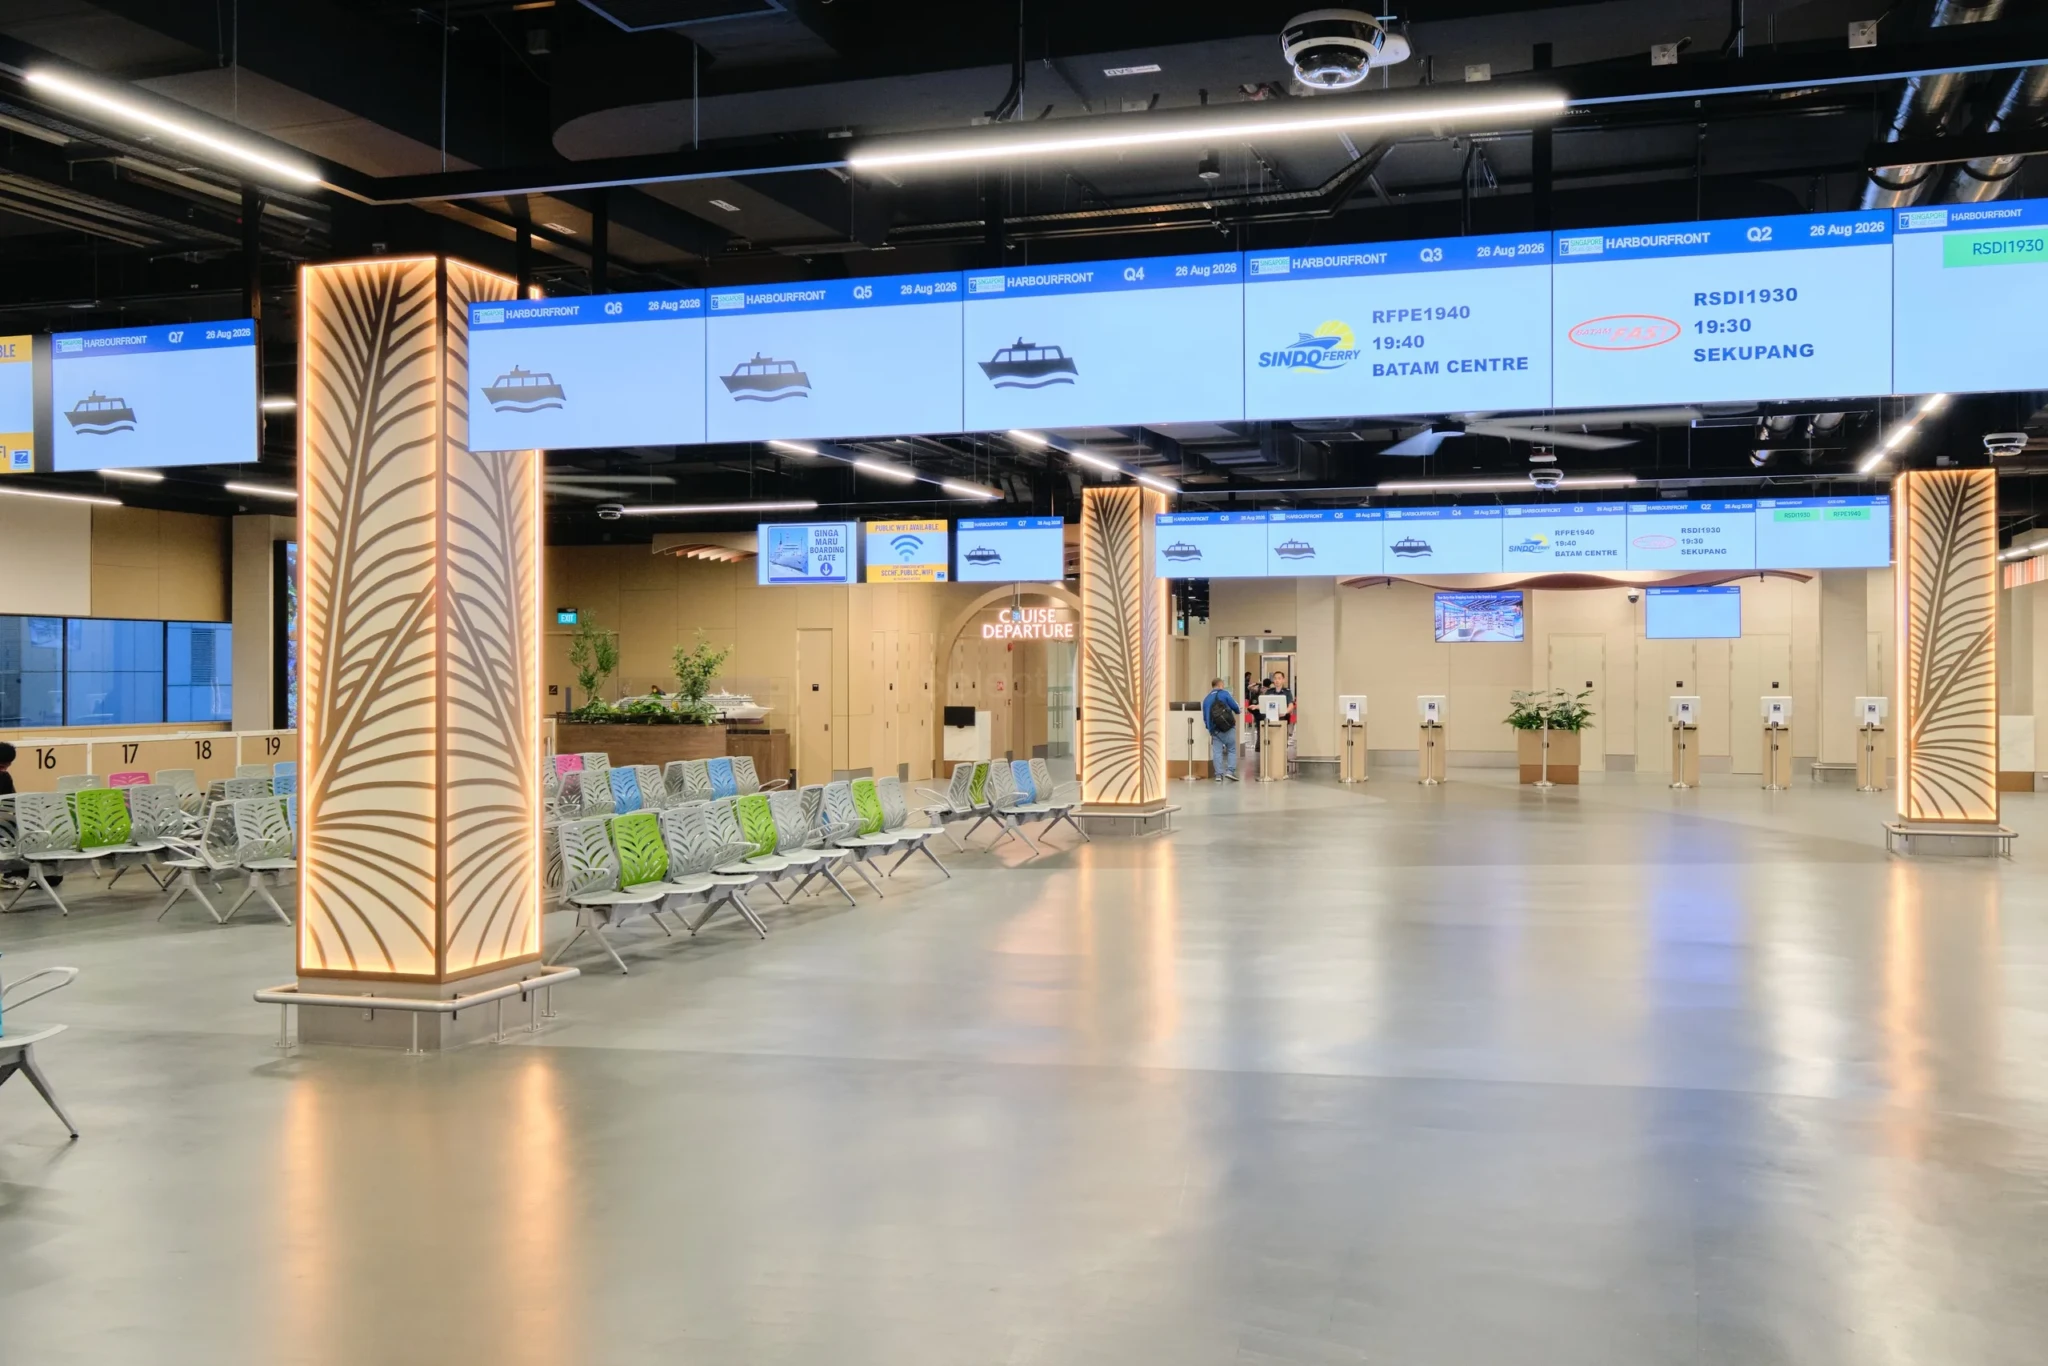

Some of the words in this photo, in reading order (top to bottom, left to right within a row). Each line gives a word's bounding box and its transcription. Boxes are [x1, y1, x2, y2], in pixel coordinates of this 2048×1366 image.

[1911, 212, 1946, 220] SINGAPORE
[1952, 208, 2022, 221] HARBOURFRONT
[1747, 227, 1771, 242] Q2
[1810, 225, 1825, 237] 26
[1828, 224, 1852, 237] Aug
[1855, 221, 1884, 233] 2026
[1606, 232, 1710, 249] HARBOURFRONT
[1973, 239, 2043, 255] RSDI1930
[1420, 248, 1442, 262] Q3
[1477, 246, 1490, 257] 26
[1494, 246, 1515, 257] Aug
[1518, 243, 1544, 254] 2026
[1292, 252, 1387, 268] HARBOURFRONT
[1124, 268, 1144, 281] Q4
[1175, 266, 1188, 277] 26
[1190, 265, 1210, 276] Aug
[1213, 263, 1237, 274] 2026
[1007, 272, 1093, 288] HARBOURFRONT
[853, 286, 872, 299] Q5
[901, 285, 912, 295] 26
[914, 284, 932, 295] Aug
[935, 282, 956, 293] 2026
[746, 291, 826, 304] HARBOURFRONT
[1694, 287, 1797, 306] RSDI1930
[605, 302, 622, 315] Q6
[649, 301, 659, 311] 26
[661, 301, 678, 311] Aug
[680, 299, 700, 308] 2026
[506, 306, 579, 320] HARBOURFRONT
[1372, 306, 1470, 323] RFPE1940
[1694, 319, 1752, 334] 19:30
[168, 332, 184, 343] Q7
[206, 331, 215, 340] 26
[216, 330, 231, 340] Aug
[233, 328, 250, 338] 2026
[84, 336, 147, 347] HARBOURFRONT
[1372, 335, 1424, 350] 19:40
[1258, 350, 1322, 367] SINDO
[1323, 350, 1361, 361] FERRY
[1694, 344, 1814, 362] SEKUPANG
[1372, 361, 1439, 376] BATAM
[1446, 357, 1528, 373] CENTRE
[561, 614, 573, 622] EXIT
[982, 624, 1074, 638] DEPARTURE
[195, 741, 212, 759] 18
[266, 737, 280, 756] 19
[36, 748, 56, 769] 16
[122, 744, 139, 764] 17
